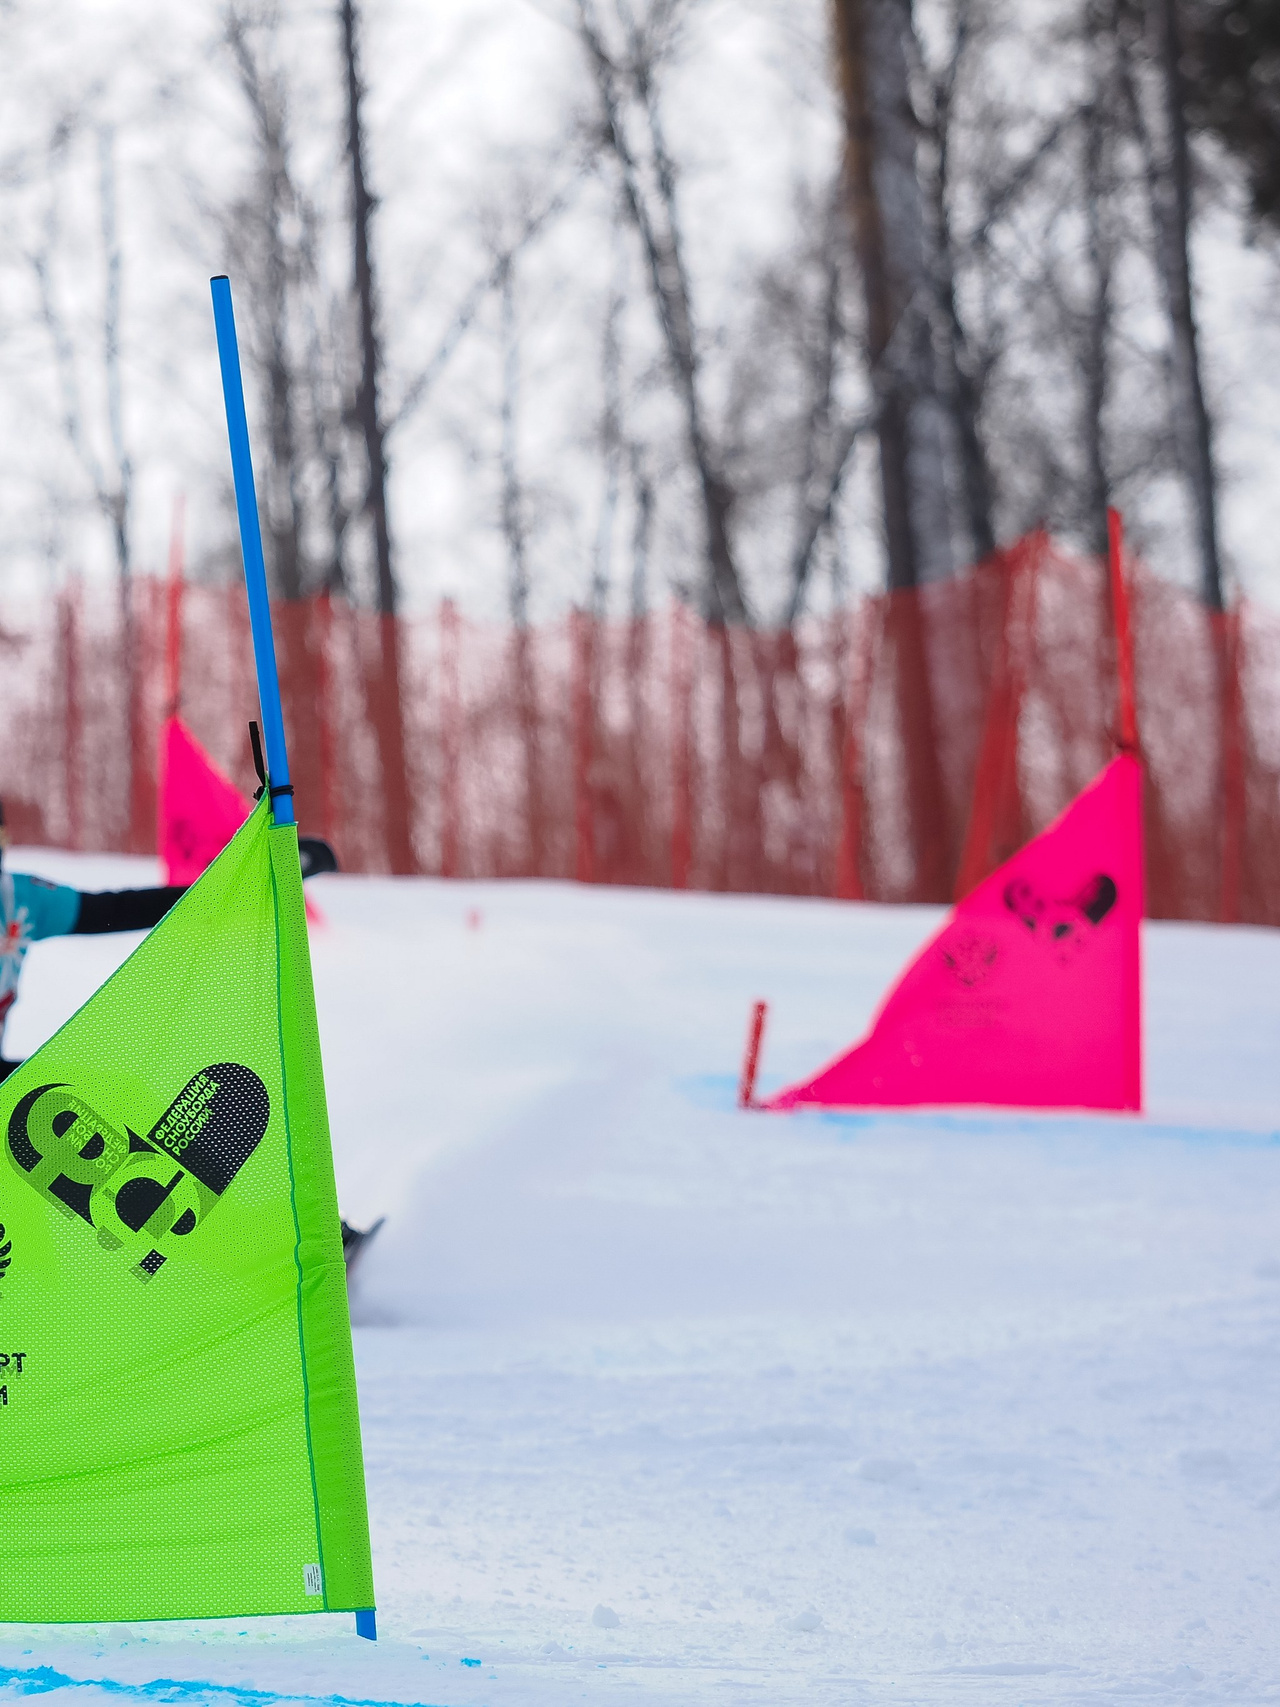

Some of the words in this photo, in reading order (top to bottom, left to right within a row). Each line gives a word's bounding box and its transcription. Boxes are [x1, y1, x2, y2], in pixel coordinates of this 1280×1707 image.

[155, 1073, 210, 1140] ФЕДЕРАЦИЯ
[163, 1080, 221, 1148] СНОУБОРДА
[171, 1107, 214, 1156] РОССИИ
